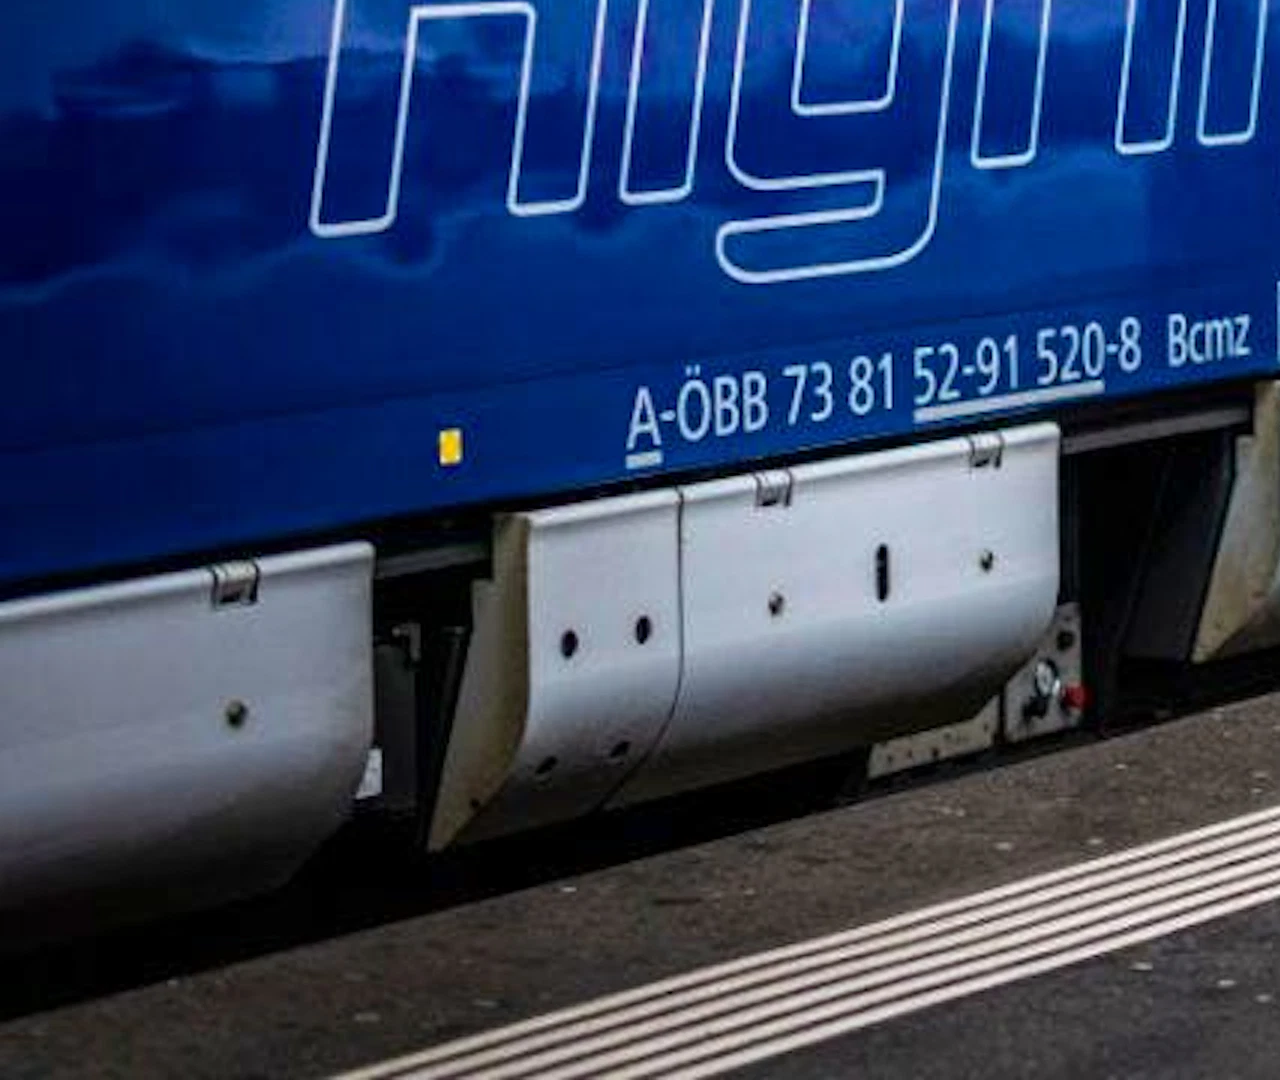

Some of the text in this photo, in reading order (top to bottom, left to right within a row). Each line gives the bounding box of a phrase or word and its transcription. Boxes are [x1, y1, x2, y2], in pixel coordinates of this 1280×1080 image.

[625, 313, 1250, 453] A-ÖBB 73 81 52-91 520-8 Bcmz
